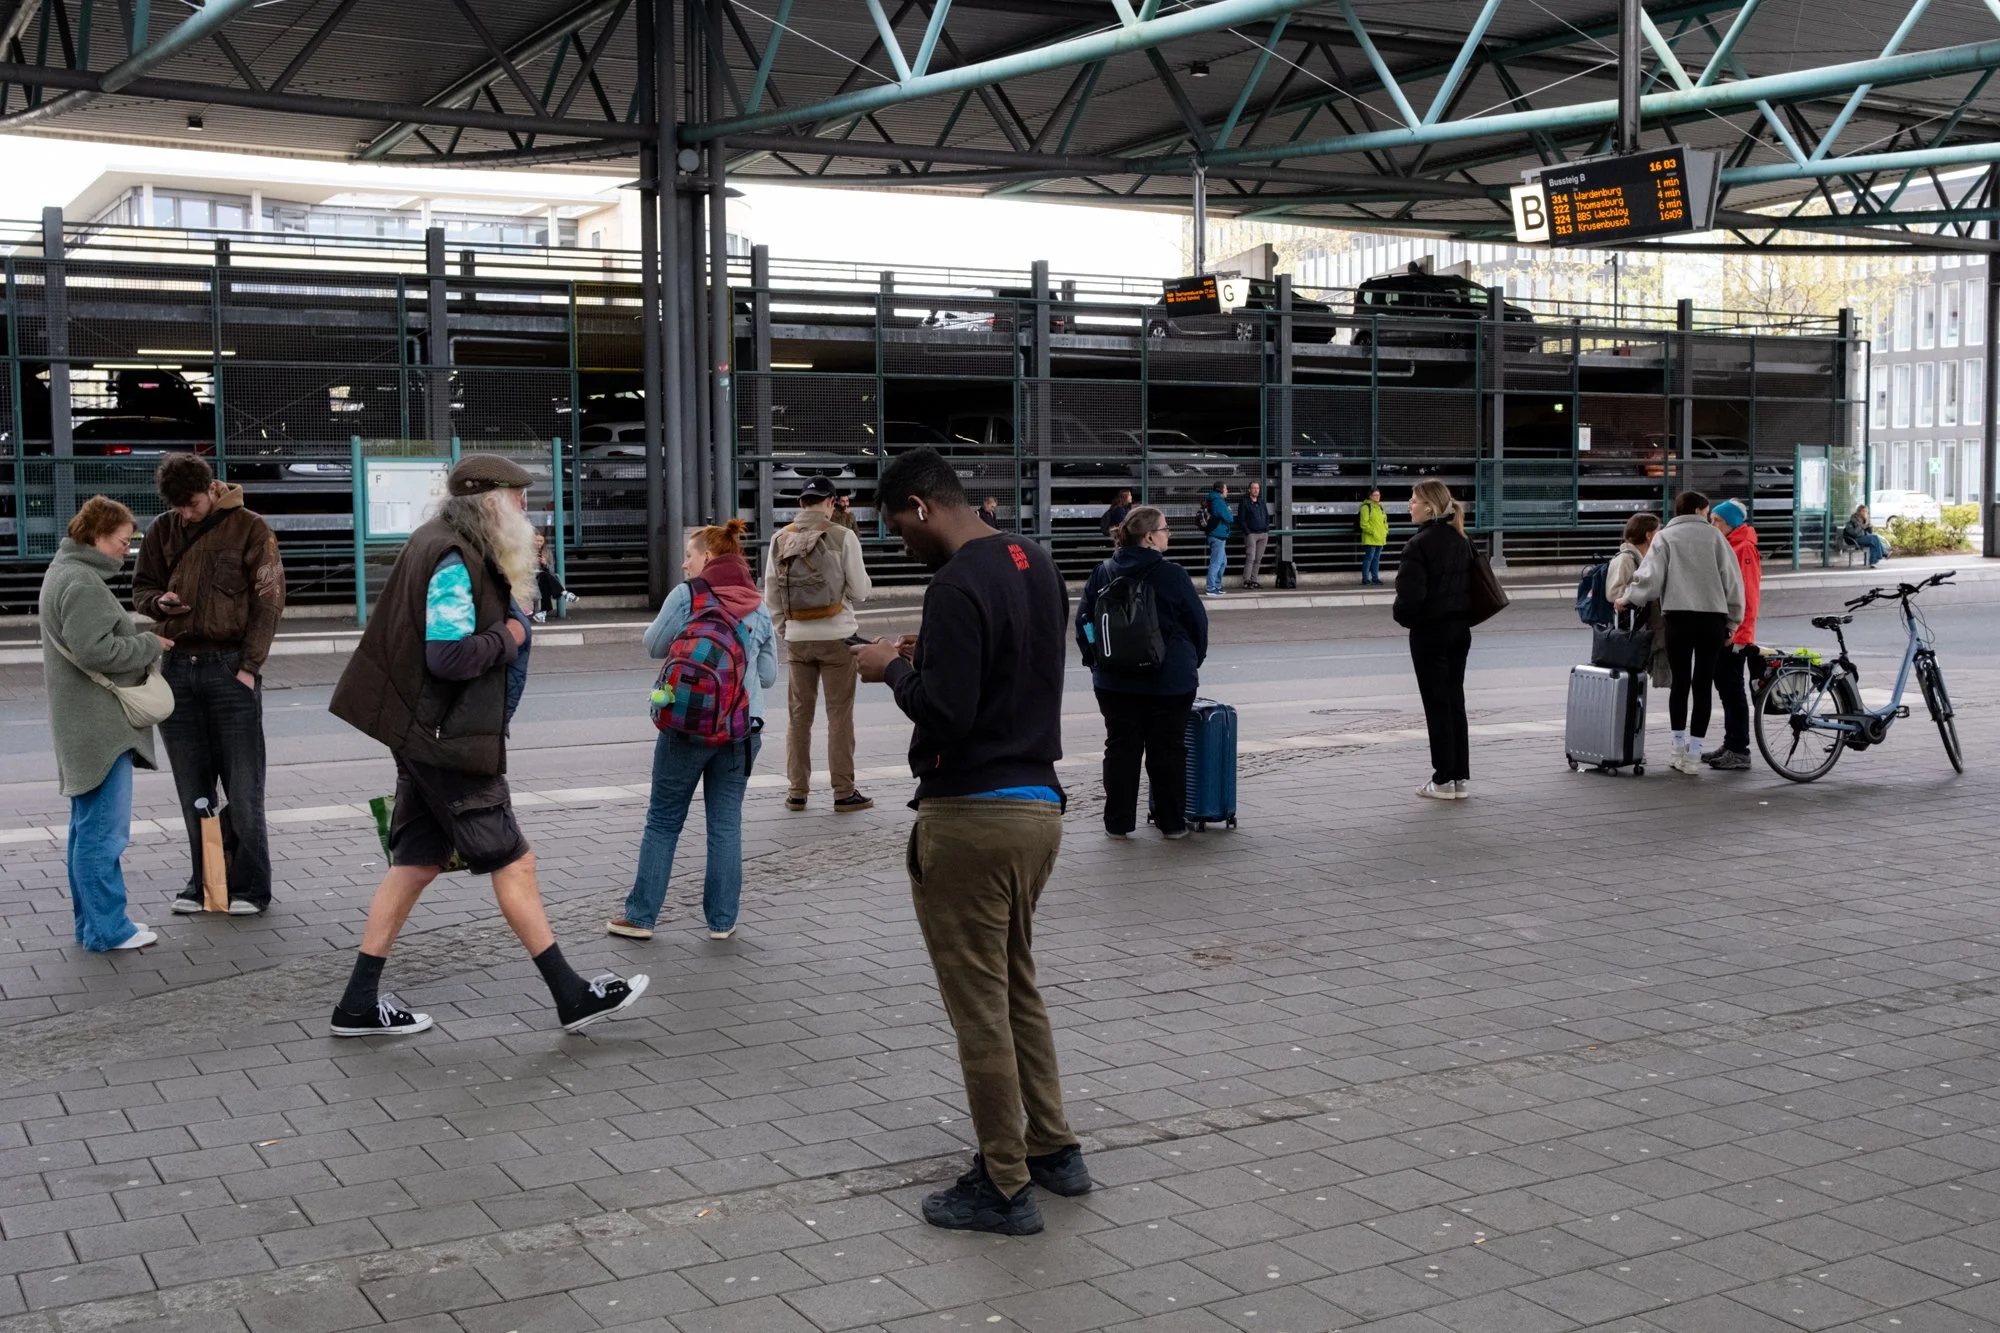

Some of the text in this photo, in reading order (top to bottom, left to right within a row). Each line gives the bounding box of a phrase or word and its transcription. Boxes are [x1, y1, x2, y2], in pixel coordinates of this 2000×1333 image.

[1549, 174, 1585, 186] Bussteig B
[1551, 194, 1568, 204] 314
[1573, 187, 1622, 201] Wardenburg
[1656, 179, 1661, 188] 1
[1663, 177, 1679, 187] min
[1553, 188, 1681, 214] 322 Thomasburg 4 min
[1521, 195, 1545, 231] B
[1554, 199, 1682, 225] 324 BBS Wechloy 6 min
[1556, 209, 1682, 234] 313 Krusenbusch 16:09
[1223, 284, 1234, 302] G
[376, 475, 381, 484] F
[1008, 544, 1022, 553] MIA
[1016, 560, 1030, 571] MIA
